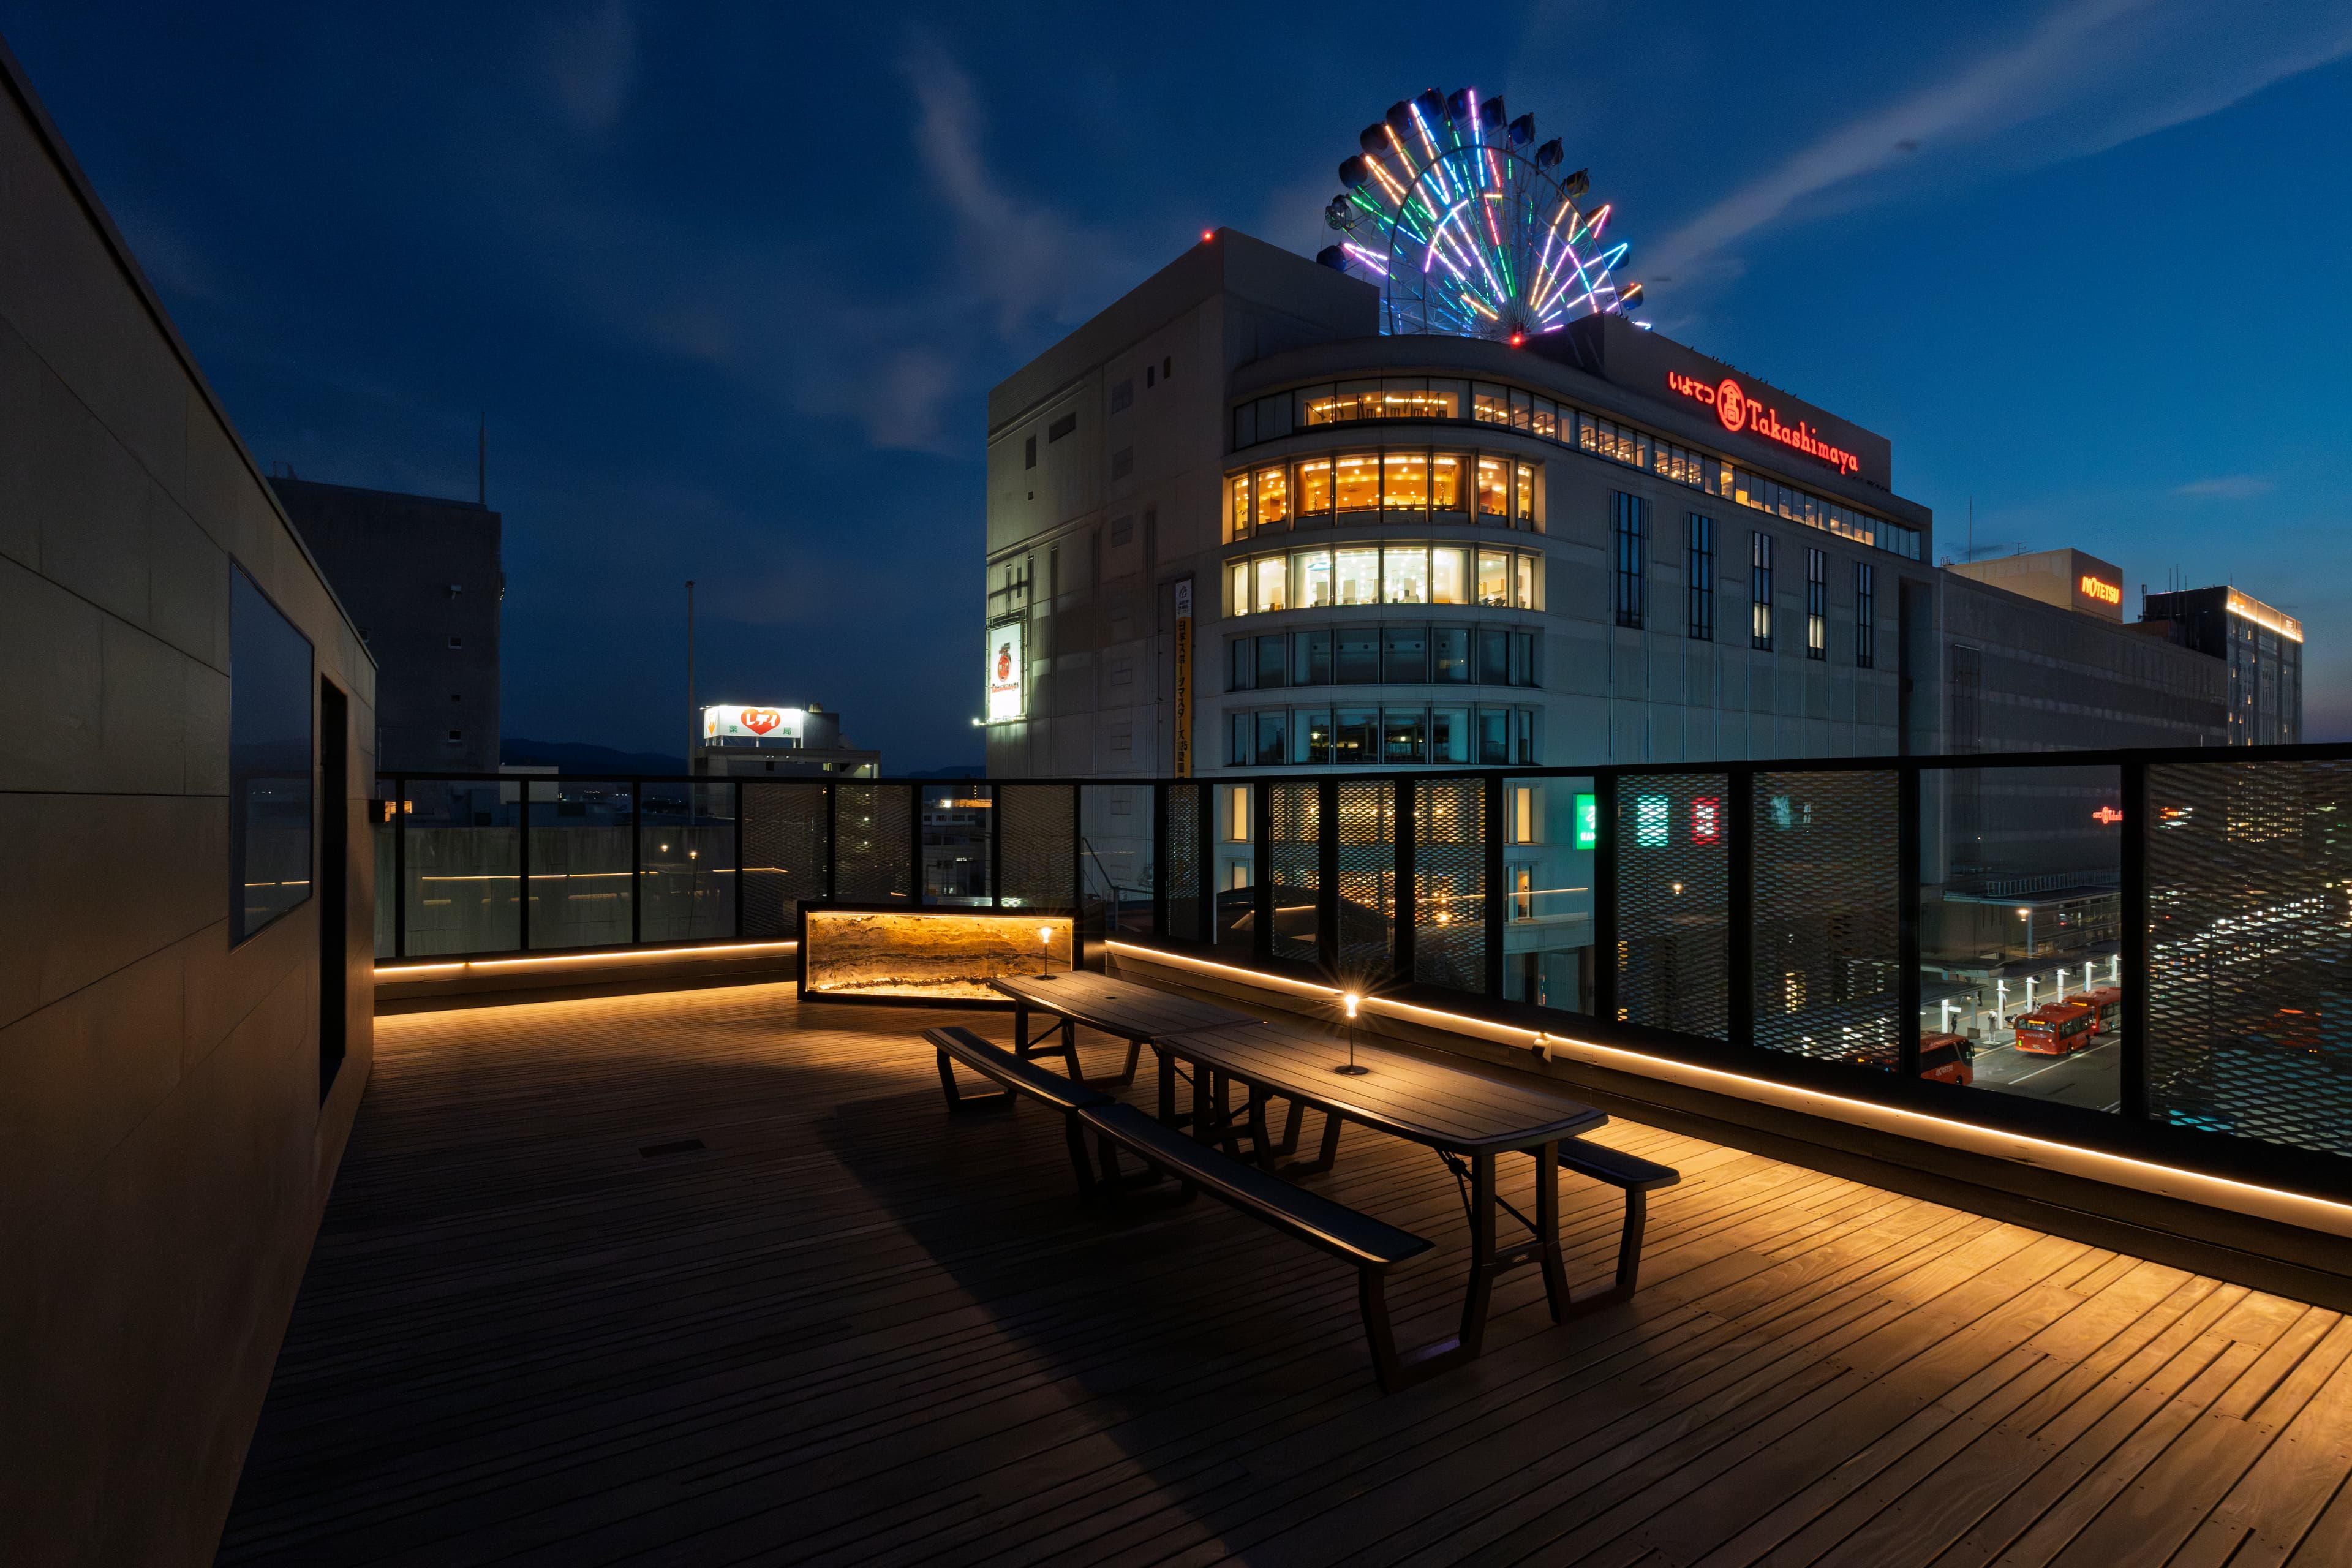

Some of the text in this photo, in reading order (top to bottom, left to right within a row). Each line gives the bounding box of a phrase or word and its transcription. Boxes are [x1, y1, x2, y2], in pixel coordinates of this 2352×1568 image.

[1668, 371, 1715, 404] いよてつ
[1747, 398, 1859, 475] Takashimaya
[2082, 576, 2119, 604] IYOTETSU
[746, 714, 777, 727] レディ
